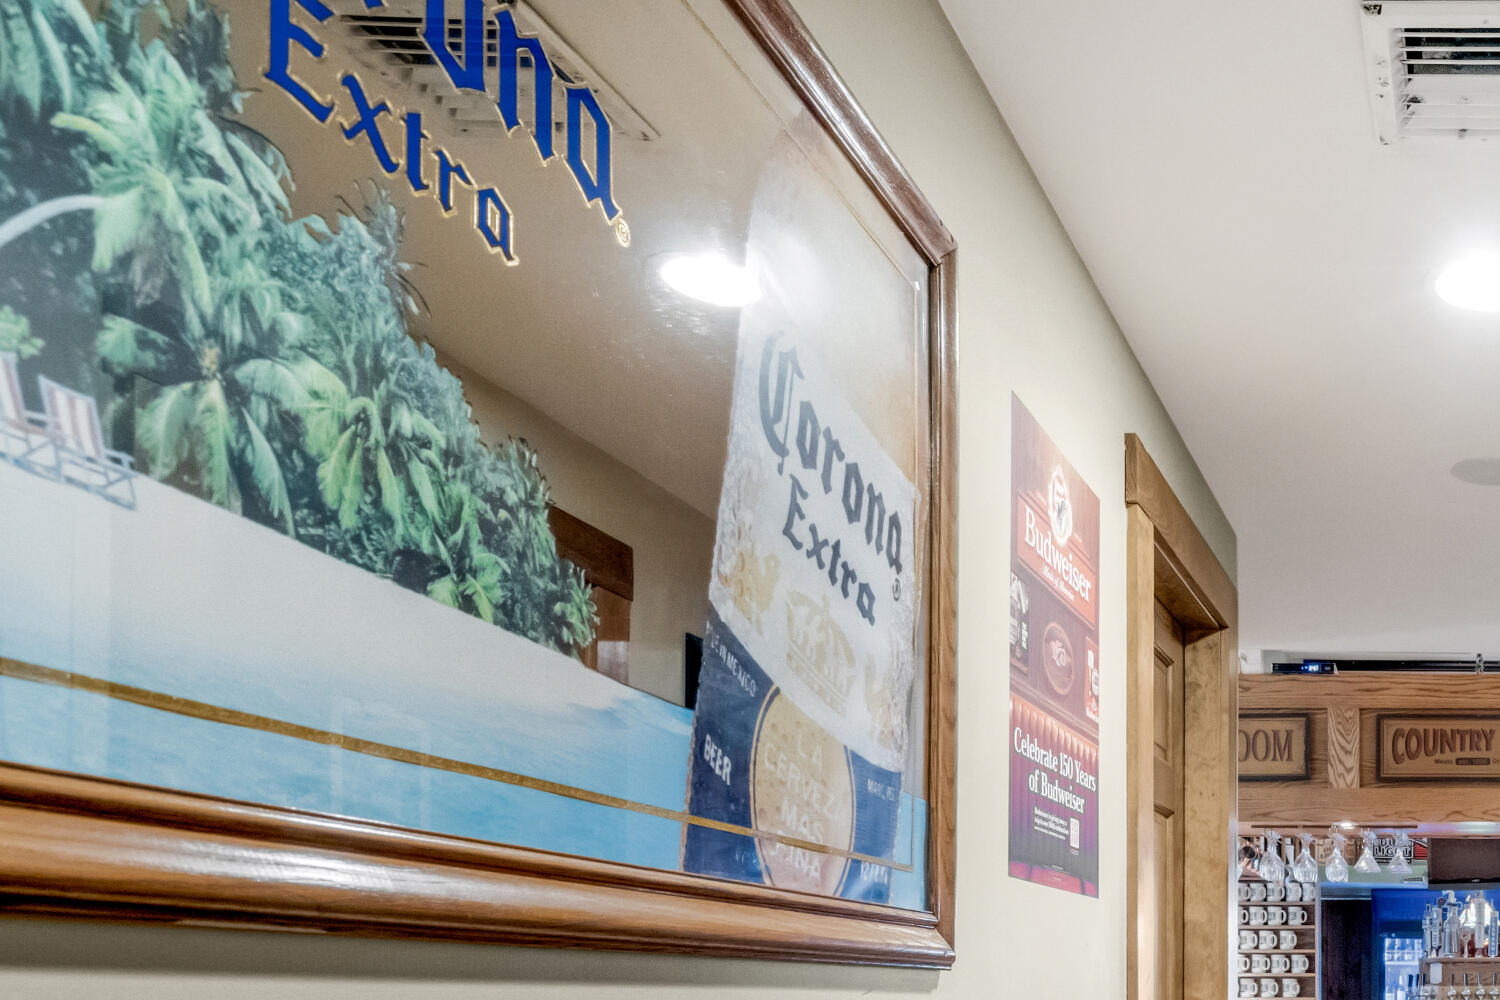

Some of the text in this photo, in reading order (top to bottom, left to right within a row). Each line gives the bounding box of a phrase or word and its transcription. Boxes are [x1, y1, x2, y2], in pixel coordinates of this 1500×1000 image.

[261, 0, 519, 266] Extra
[758, 331, 903, 575] Corona
[782, 473, 876, 627] Extra
[1024, 503, 1092, 603] Budweiser
[703, 732, 732, 786] BEER
[1014, 727, 1097, 792] Celebrate 150 Years
[1238, 728, 1294, 762] OOM
[1391, 727, 1496, 765] COUNTRY
[763, 743, 838, 820] CERVEZ
[1028, 769, 1085, 814] of Budweiser
[1373, 846, 1411, 857] LIGT
